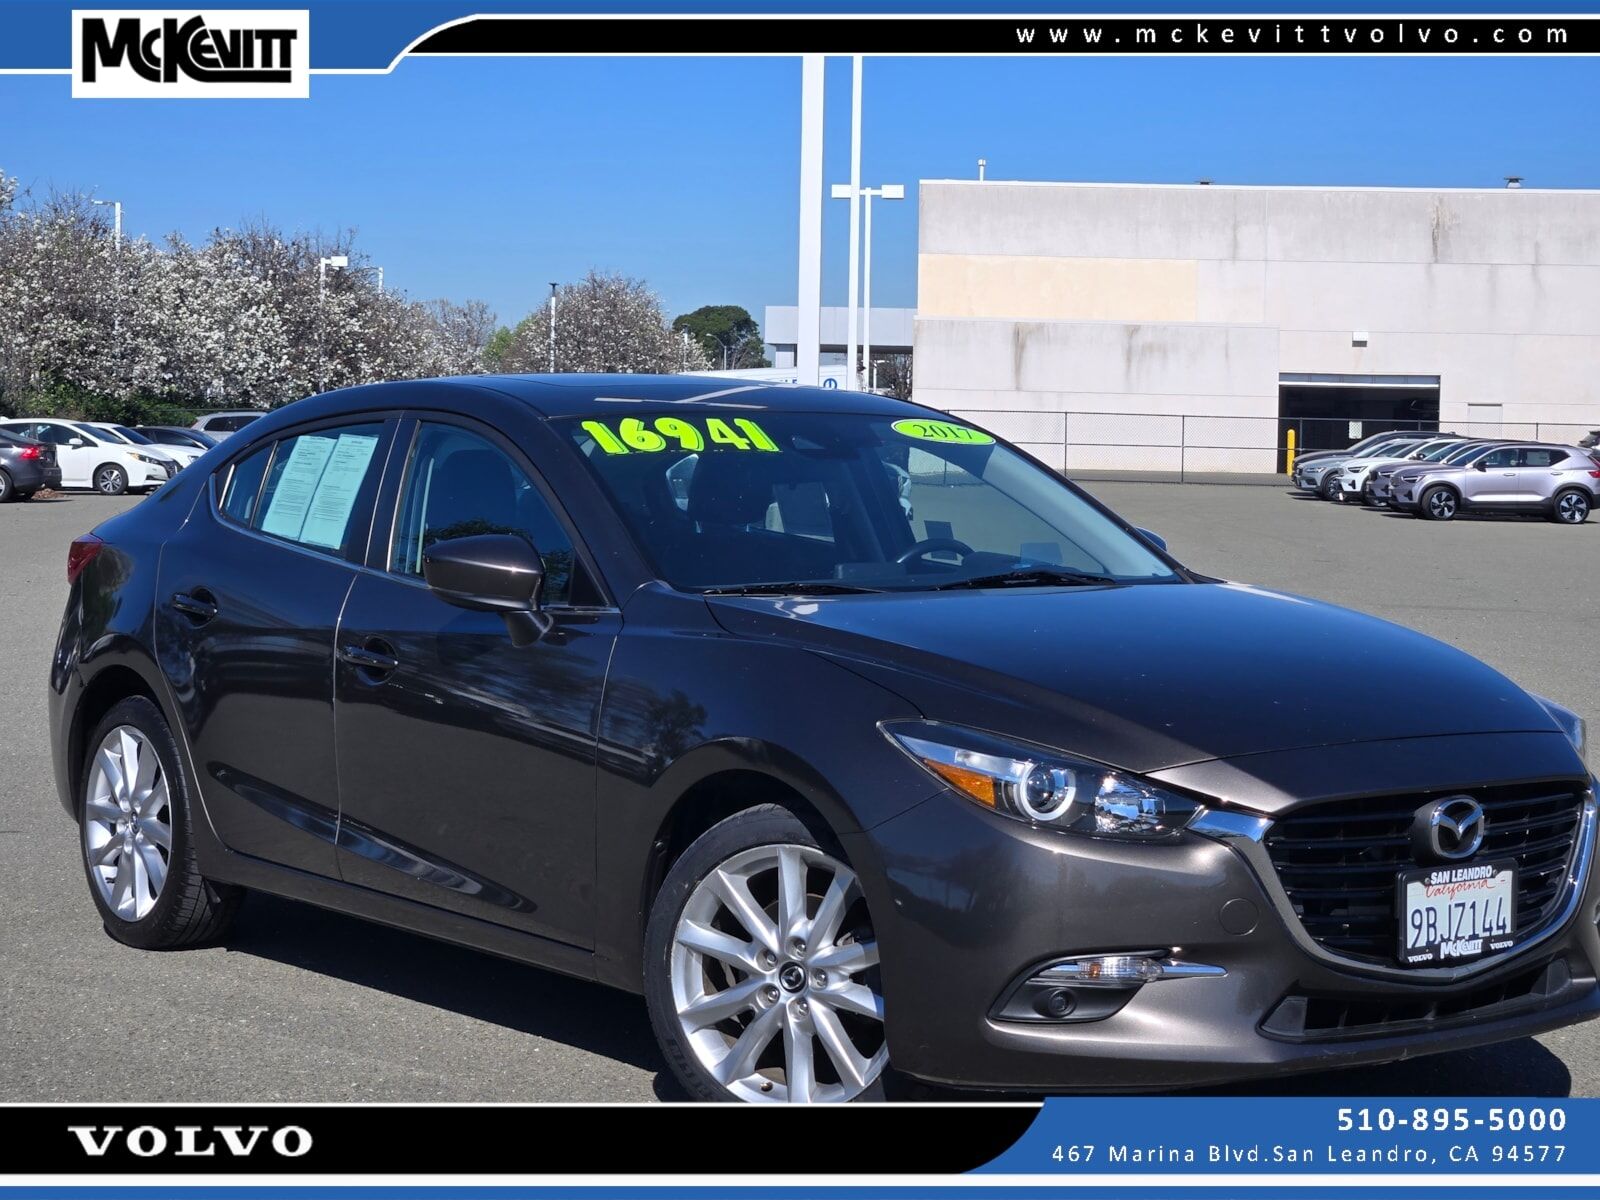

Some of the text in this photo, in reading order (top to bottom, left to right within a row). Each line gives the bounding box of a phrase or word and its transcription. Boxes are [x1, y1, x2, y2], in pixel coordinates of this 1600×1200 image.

[581, 417, 778, 455] 16941
[913, 424, 973, 440] 2017
[1430, 865, 1492, 885] SAN LEANDRO
[1425, 879, 1495, 900] California
[1411, 897, 1507, 949] 9BJZ144
[1408, 953, 1433, 963] VOLVO
[1490, 940, 1513, 950] VOLVO
